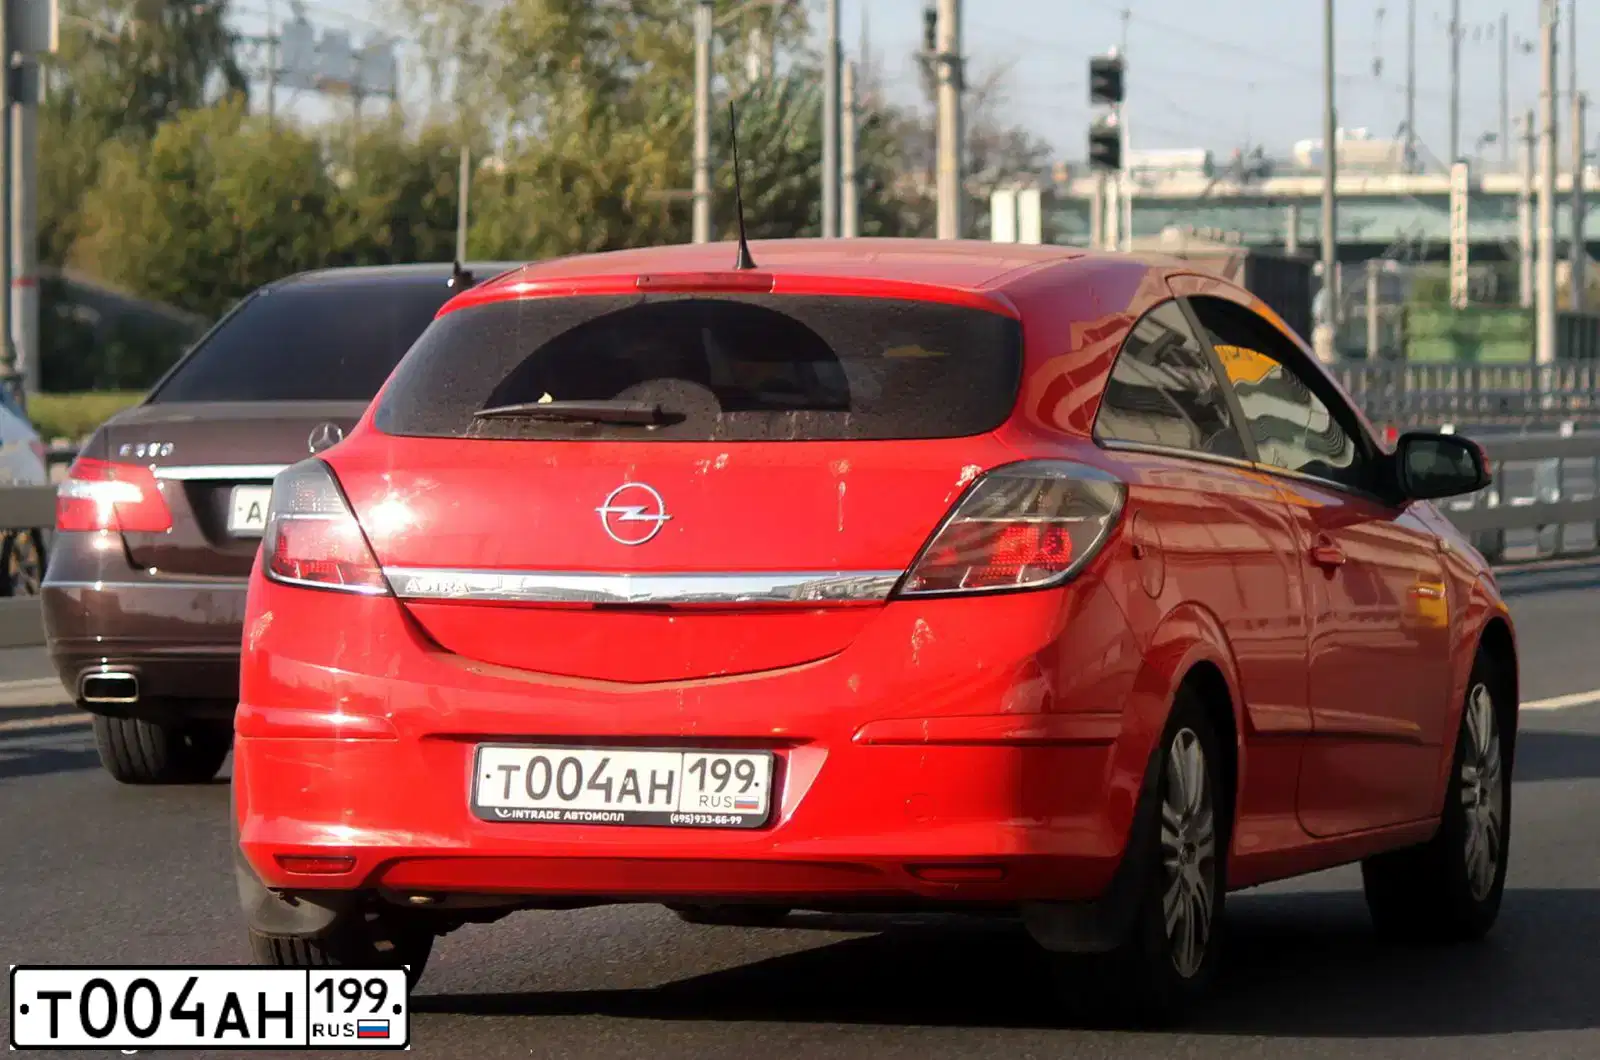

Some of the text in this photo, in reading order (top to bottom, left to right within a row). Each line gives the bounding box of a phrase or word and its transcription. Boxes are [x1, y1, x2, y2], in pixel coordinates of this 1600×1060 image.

[688, 757, 756, 794] 199
[699, 794, 733, 808] RUS
[512, 809, 625, 822] INTRADE АВТОМОЛЛ
